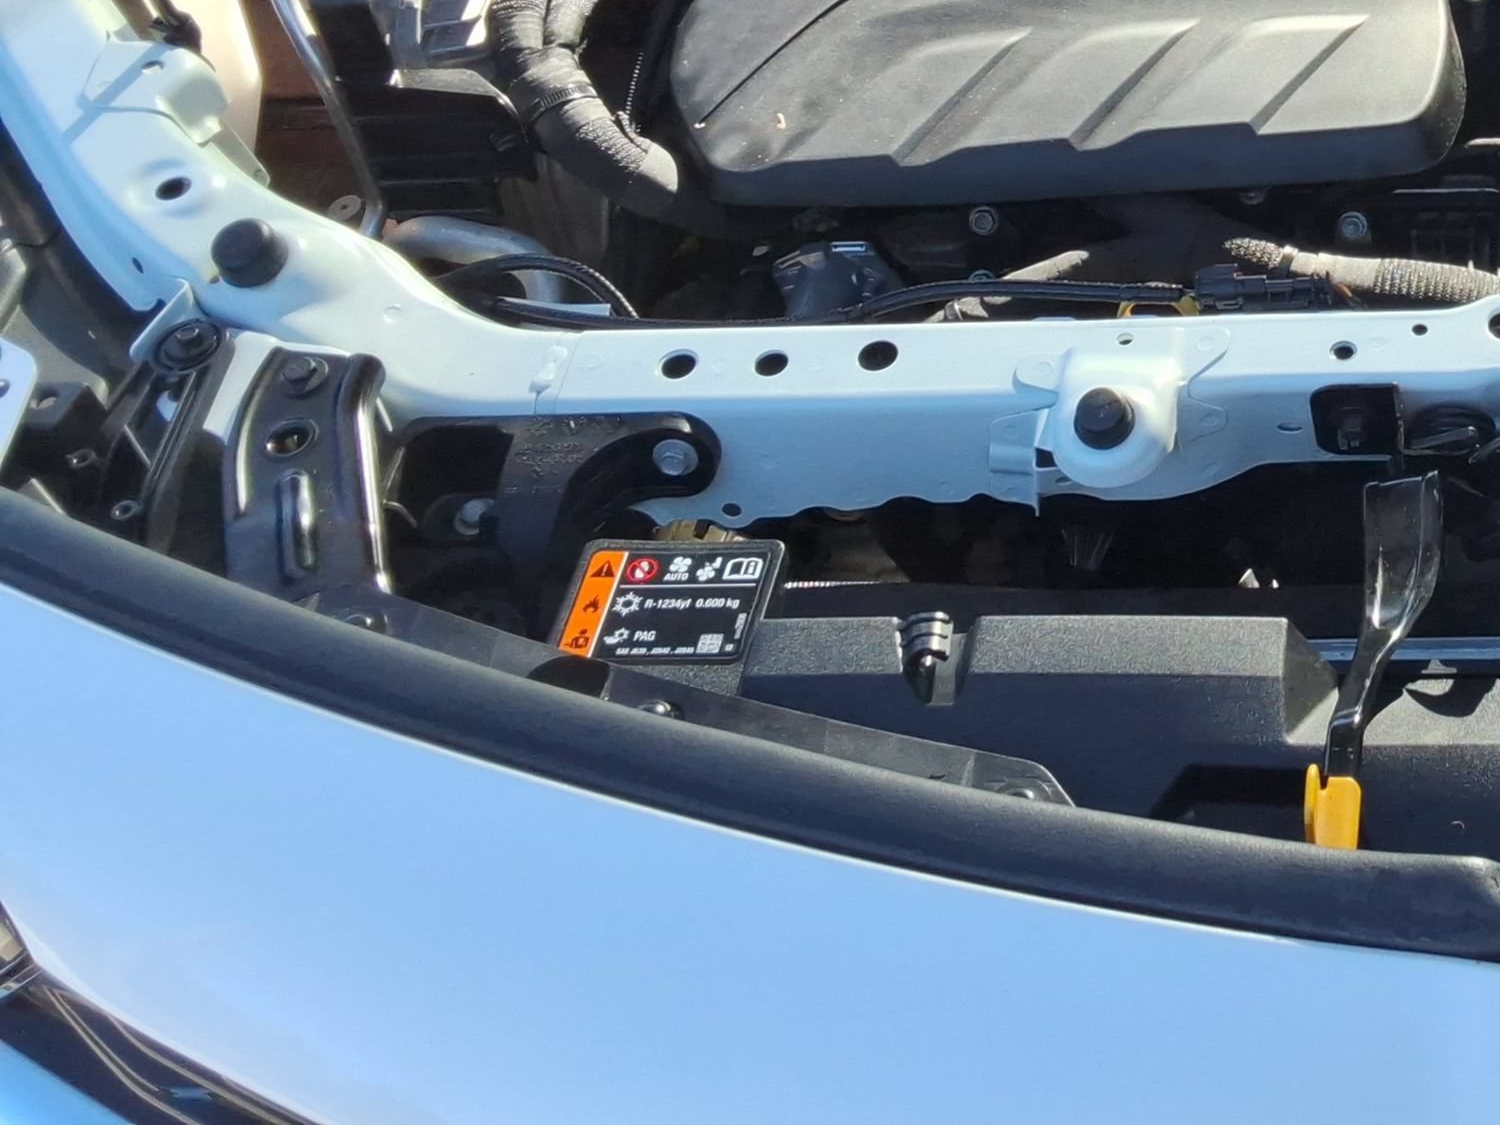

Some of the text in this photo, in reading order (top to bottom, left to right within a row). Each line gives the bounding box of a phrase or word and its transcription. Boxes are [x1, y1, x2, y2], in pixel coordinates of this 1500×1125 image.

[664, 572, 689, 580] AUTO
[644, 598, 740, 609] R-1234yf 0.600 kg
[633, 630, 657, 641] PAG
